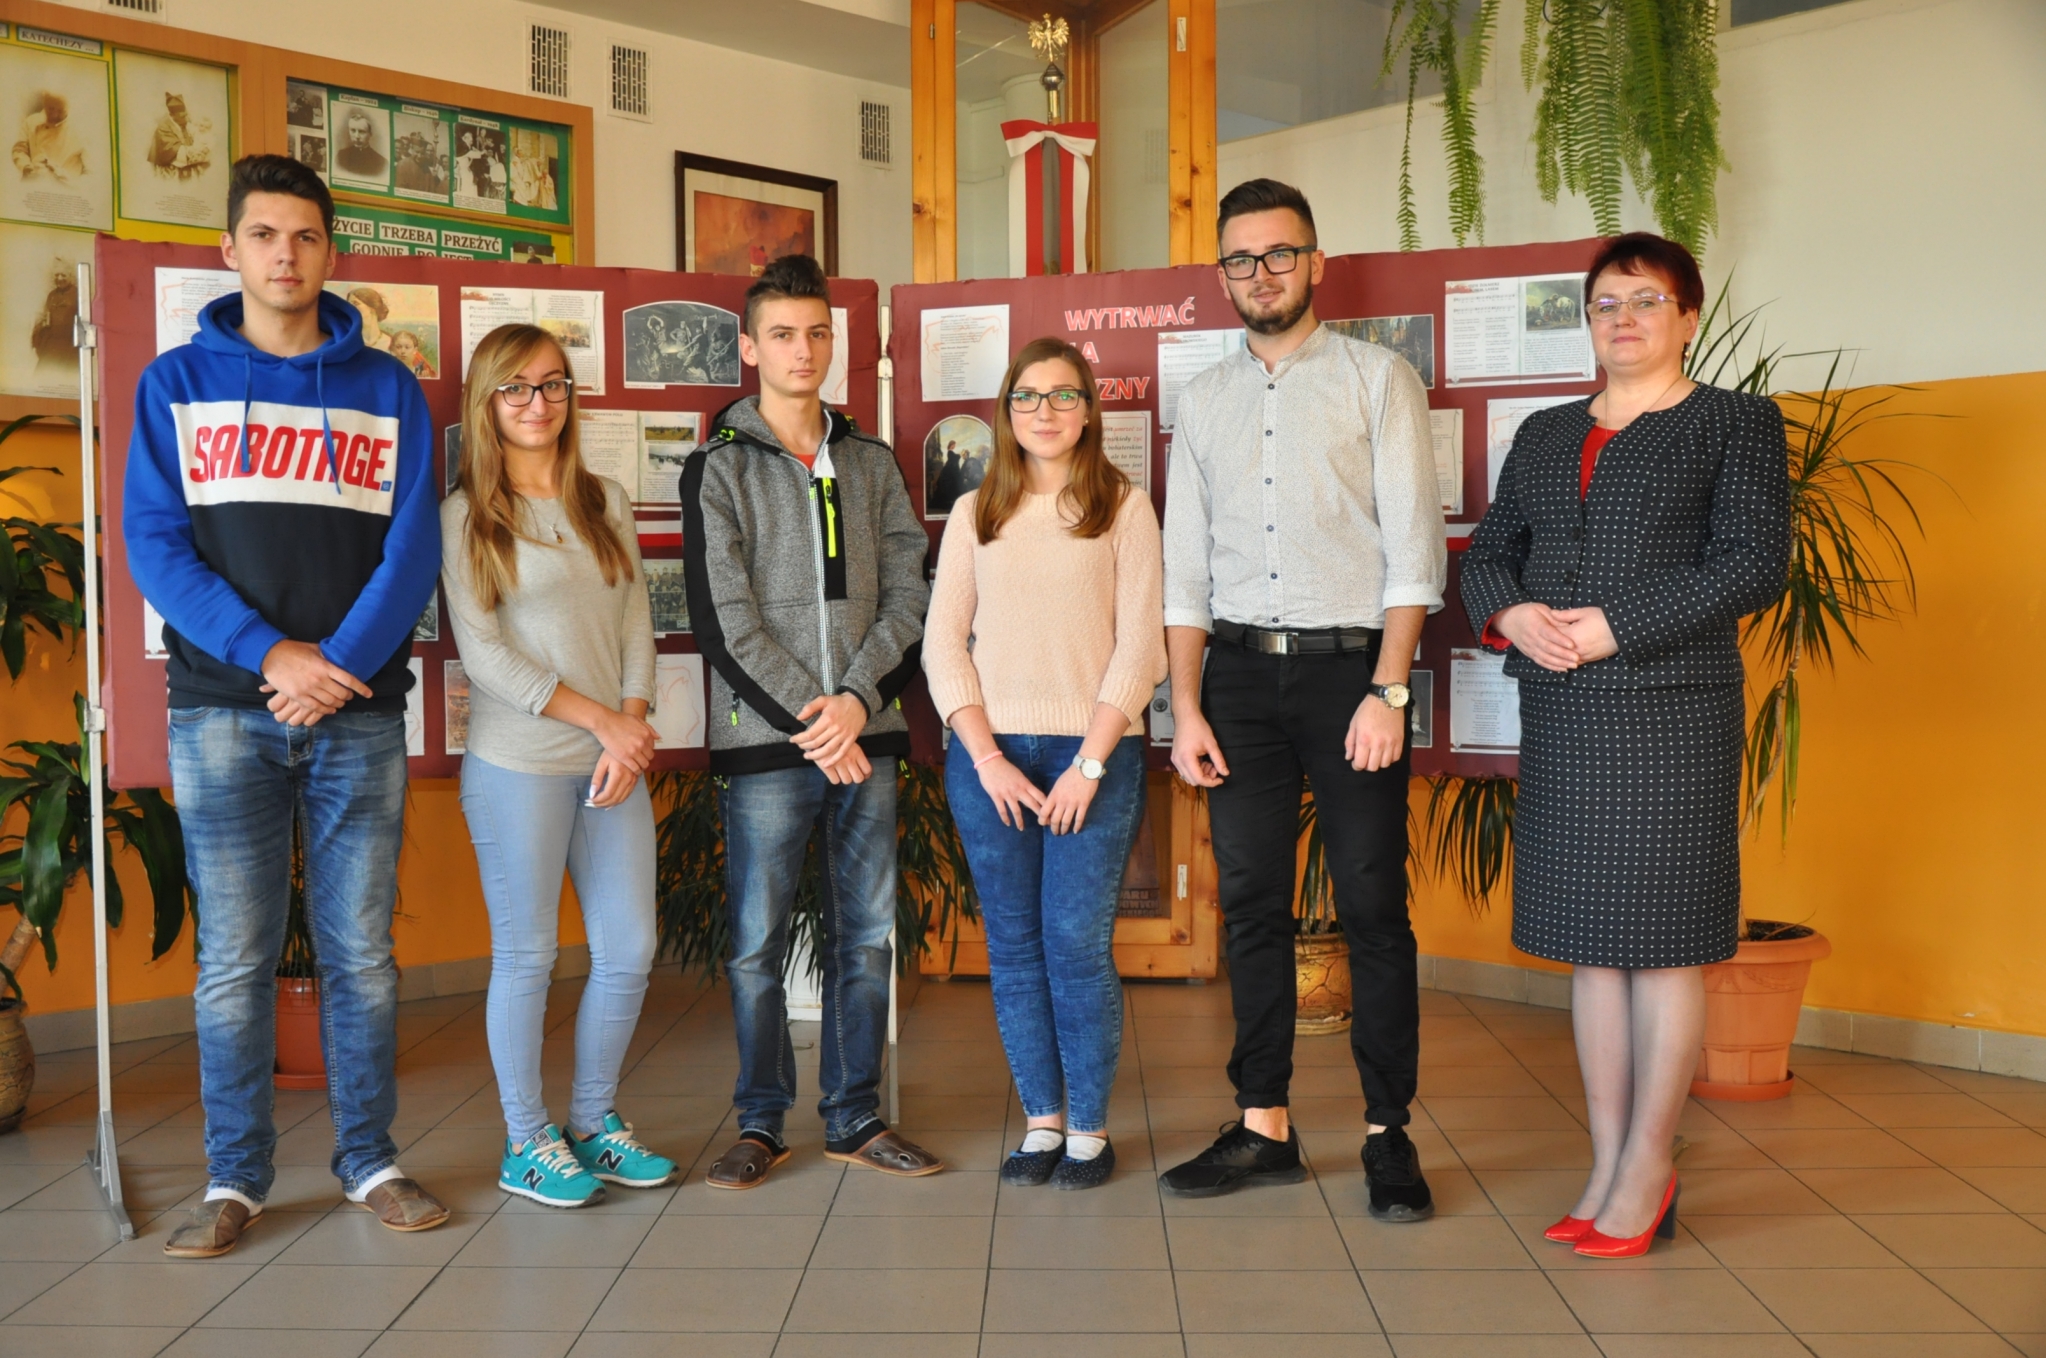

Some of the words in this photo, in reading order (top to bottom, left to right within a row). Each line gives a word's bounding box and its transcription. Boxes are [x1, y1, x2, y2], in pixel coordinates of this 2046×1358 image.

[332, 216, 372, 236] ŻYCIE
[381, 225, 434, 243] TRZEBA
[444, 233, 500, 253] PRZEŻYĆ
[1064, 296, 1195, 331] WYTRWAĆ
[596, 1147, 626, 1172] N
[522, 1166, 545, 1191] N
